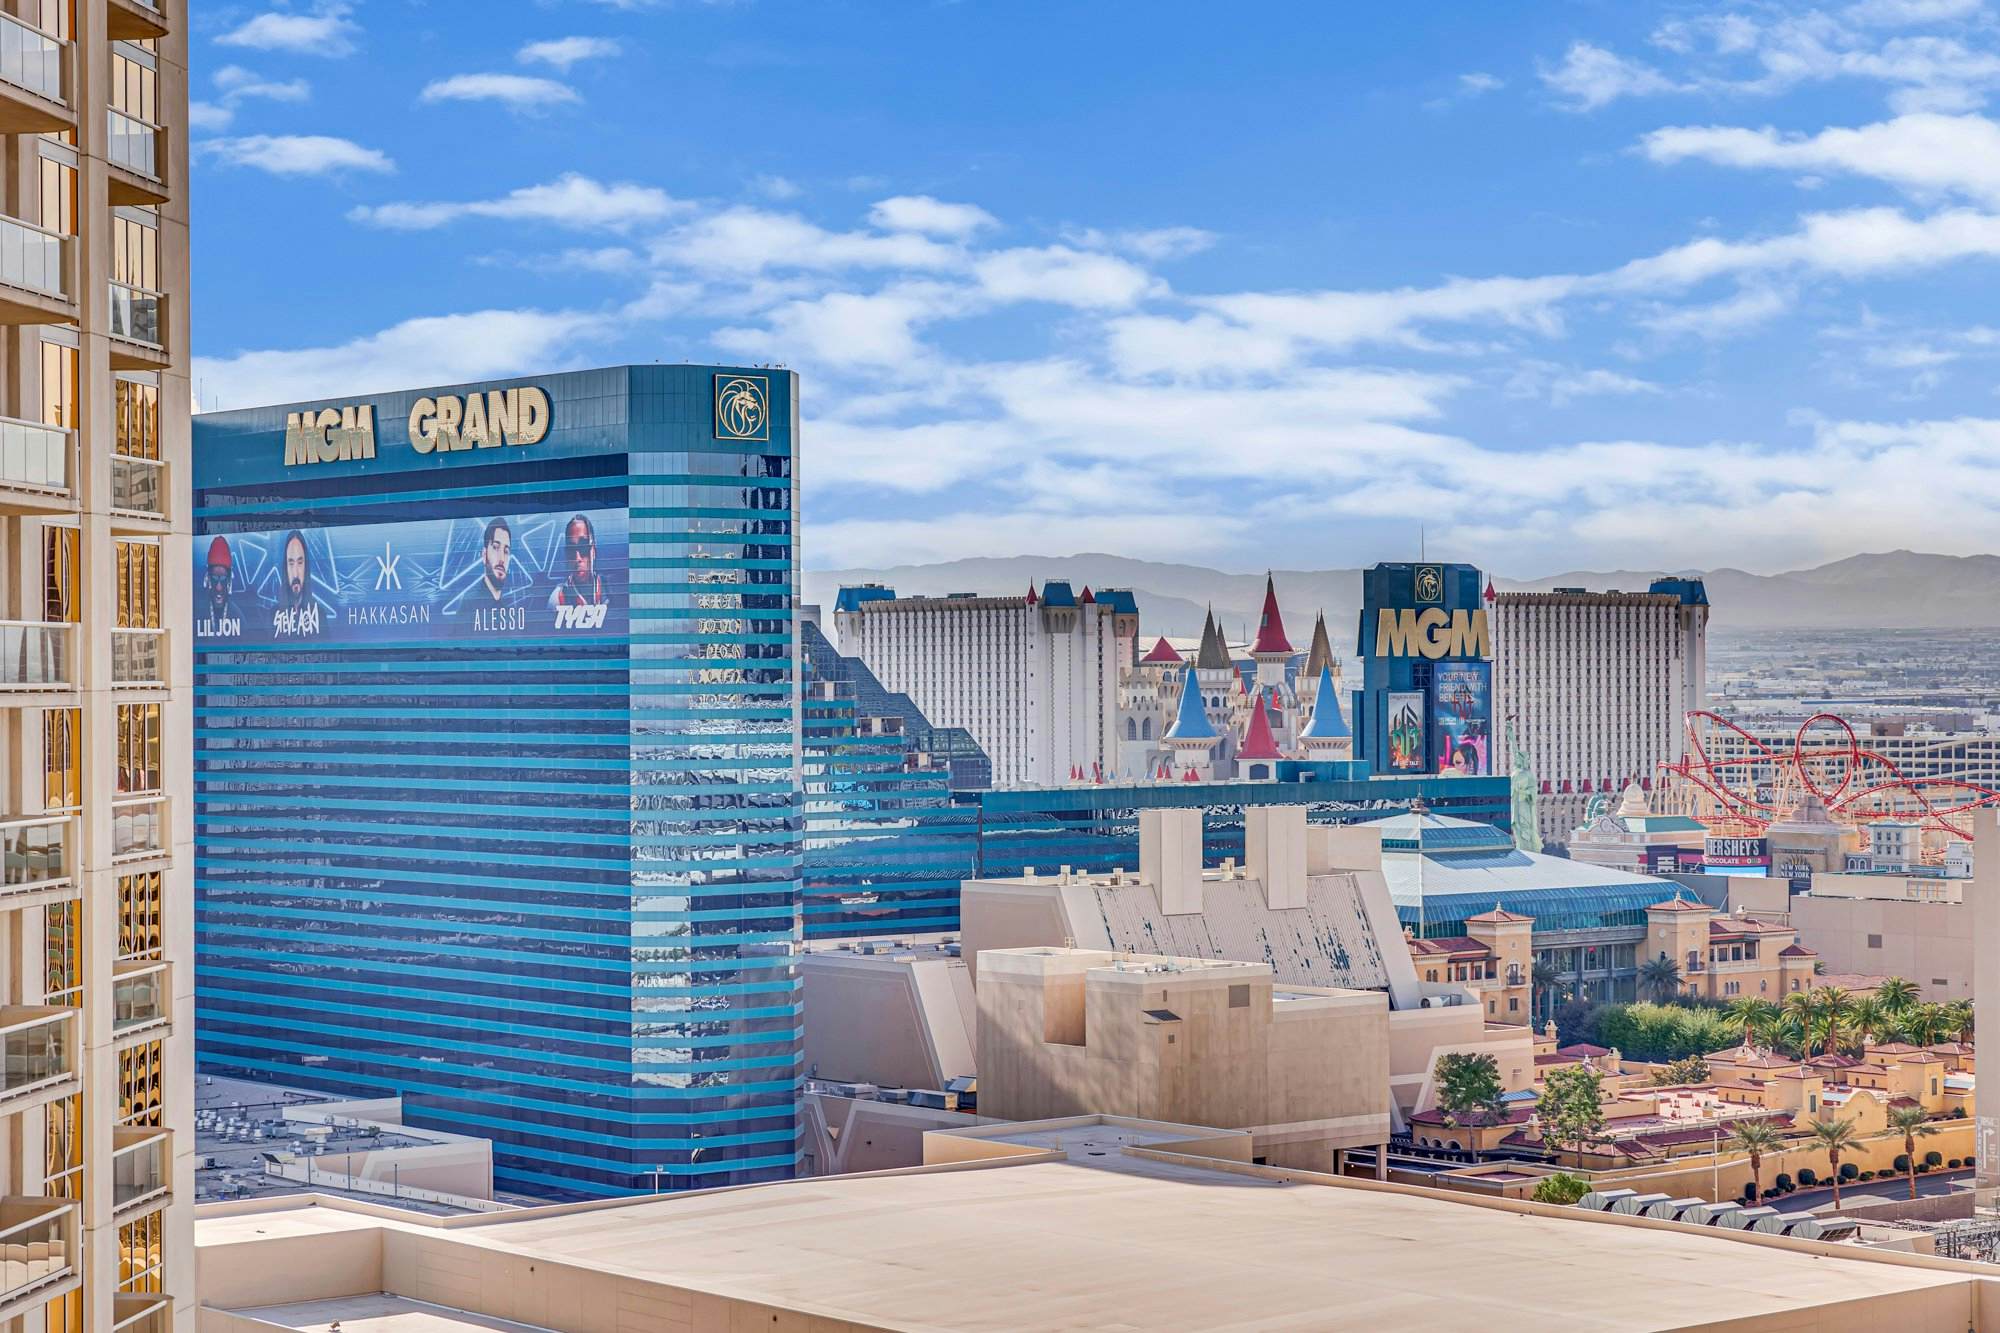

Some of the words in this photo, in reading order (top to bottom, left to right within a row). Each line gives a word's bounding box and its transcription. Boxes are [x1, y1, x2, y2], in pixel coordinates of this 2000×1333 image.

[284, 405, 376, 466] MGM
[408, 386, 550, 454] GRAND
[273, 608, 296, 638] STEVE
[348, 605, 430, 625] HAKKASAN
[474, 607, 525, 631] ALESSO
[554, 604, 608, 629] TYGA
[197, 619, 214, 637] LIL
[215, 618, 240, 637] JON
[1376, 607, 1491, 660] MGM
[1706, 839, 1760, 857] HERSHEY'S
[1795, 864, 1810, 872] YORK
[1795, 871, 1810, 879] YORK
